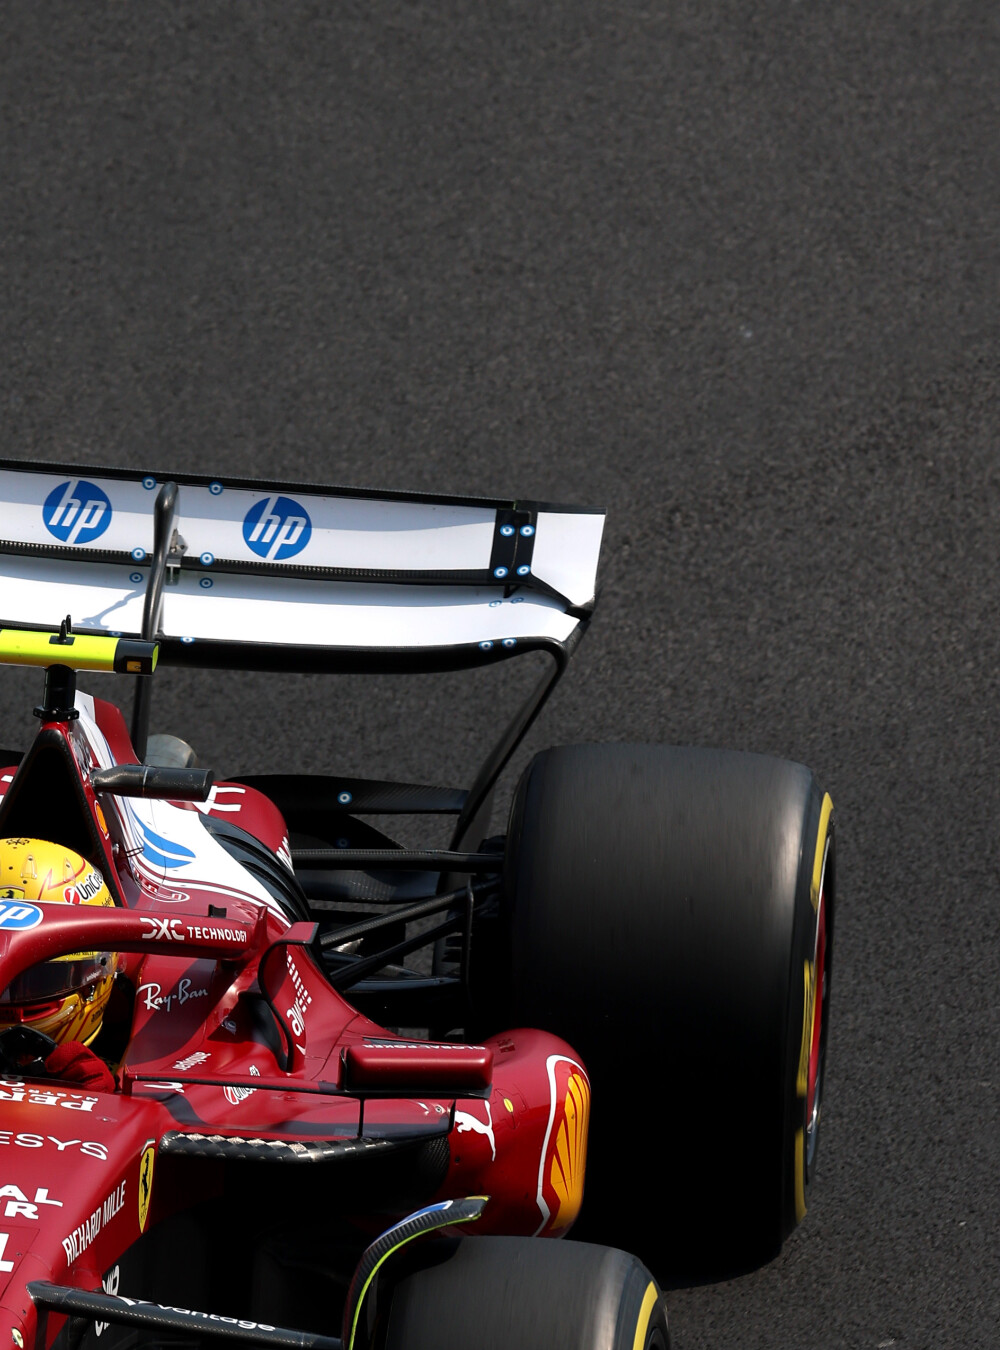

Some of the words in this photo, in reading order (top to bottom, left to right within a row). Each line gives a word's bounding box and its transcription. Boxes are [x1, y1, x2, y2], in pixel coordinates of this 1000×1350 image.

[47, 480, 108, 544] hp
[247, 497, 308, 560] hp
[140, 917, 185, 941] DXC
[187, 926, 247, 943] TECHNOLOGY
[61, 1207, 102, 1267] RICHARD
[102, 1179, 127, 1228] MILLE
